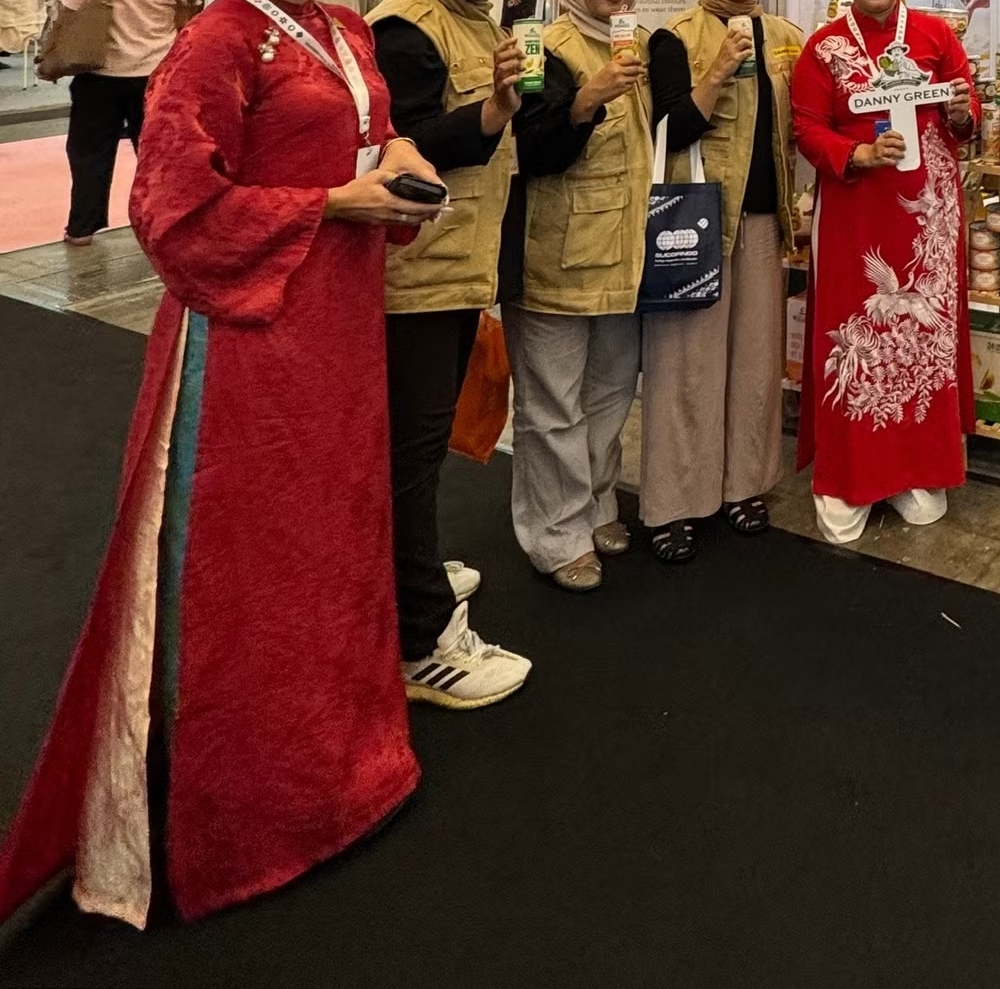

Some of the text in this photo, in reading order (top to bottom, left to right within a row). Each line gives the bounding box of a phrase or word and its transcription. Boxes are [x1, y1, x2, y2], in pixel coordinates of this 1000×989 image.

[525, 42, 540, 55] ZEN
[854, 87, 949, 108] DANNY GREEN
